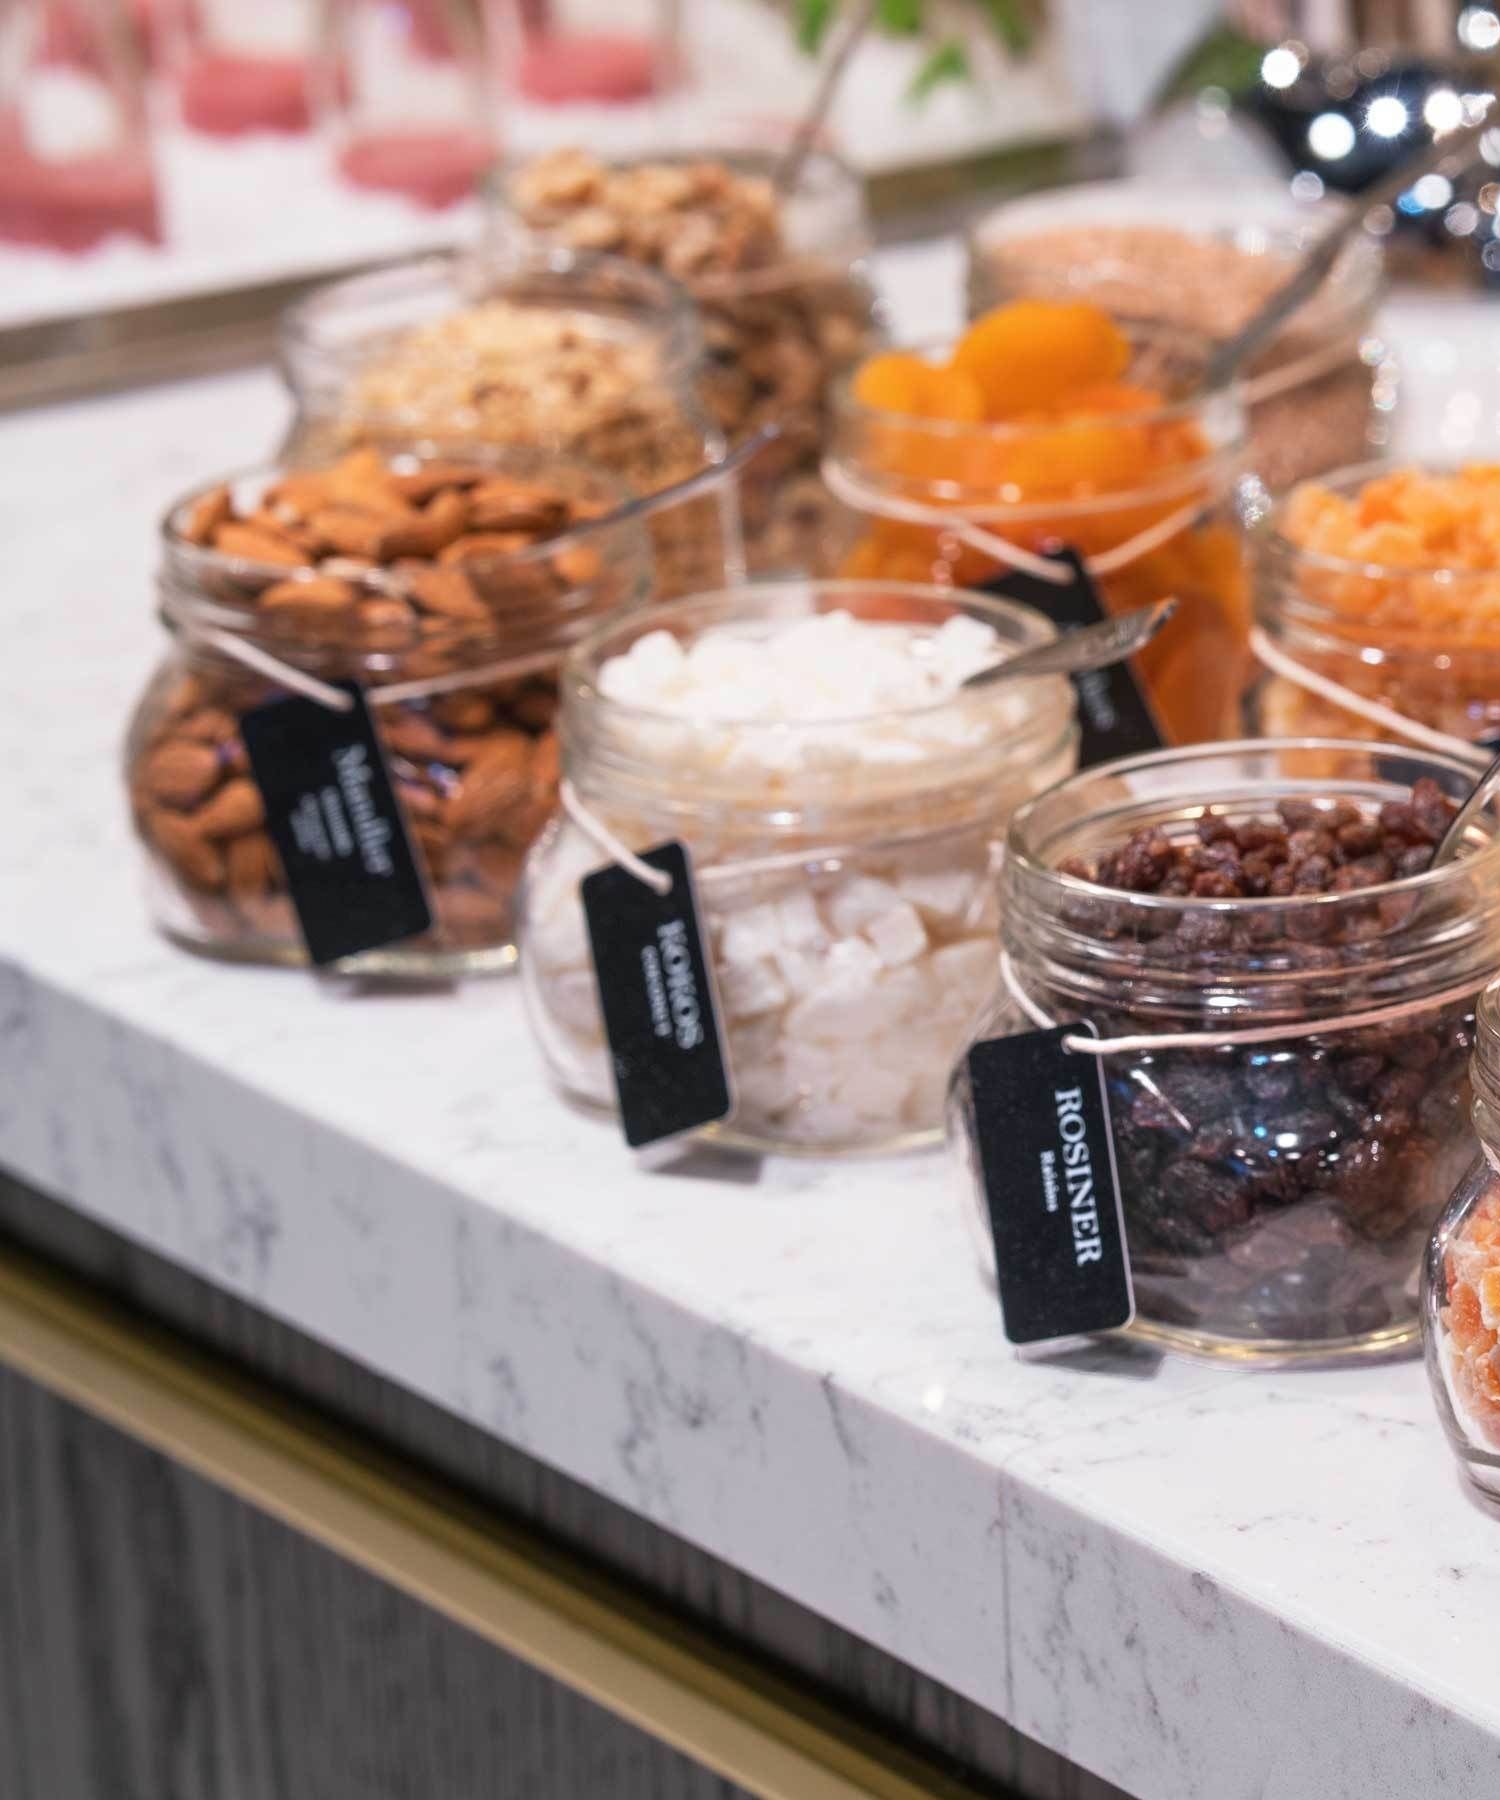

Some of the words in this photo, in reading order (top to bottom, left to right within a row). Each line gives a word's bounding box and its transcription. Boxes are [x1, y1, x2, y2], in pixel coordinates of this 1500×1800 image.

[656, 919, 704, 1049] KOKOS
[1040, 1149, 1060, 1213] Raisins
[1054, 1085, 1103, 1267] ROSINER
